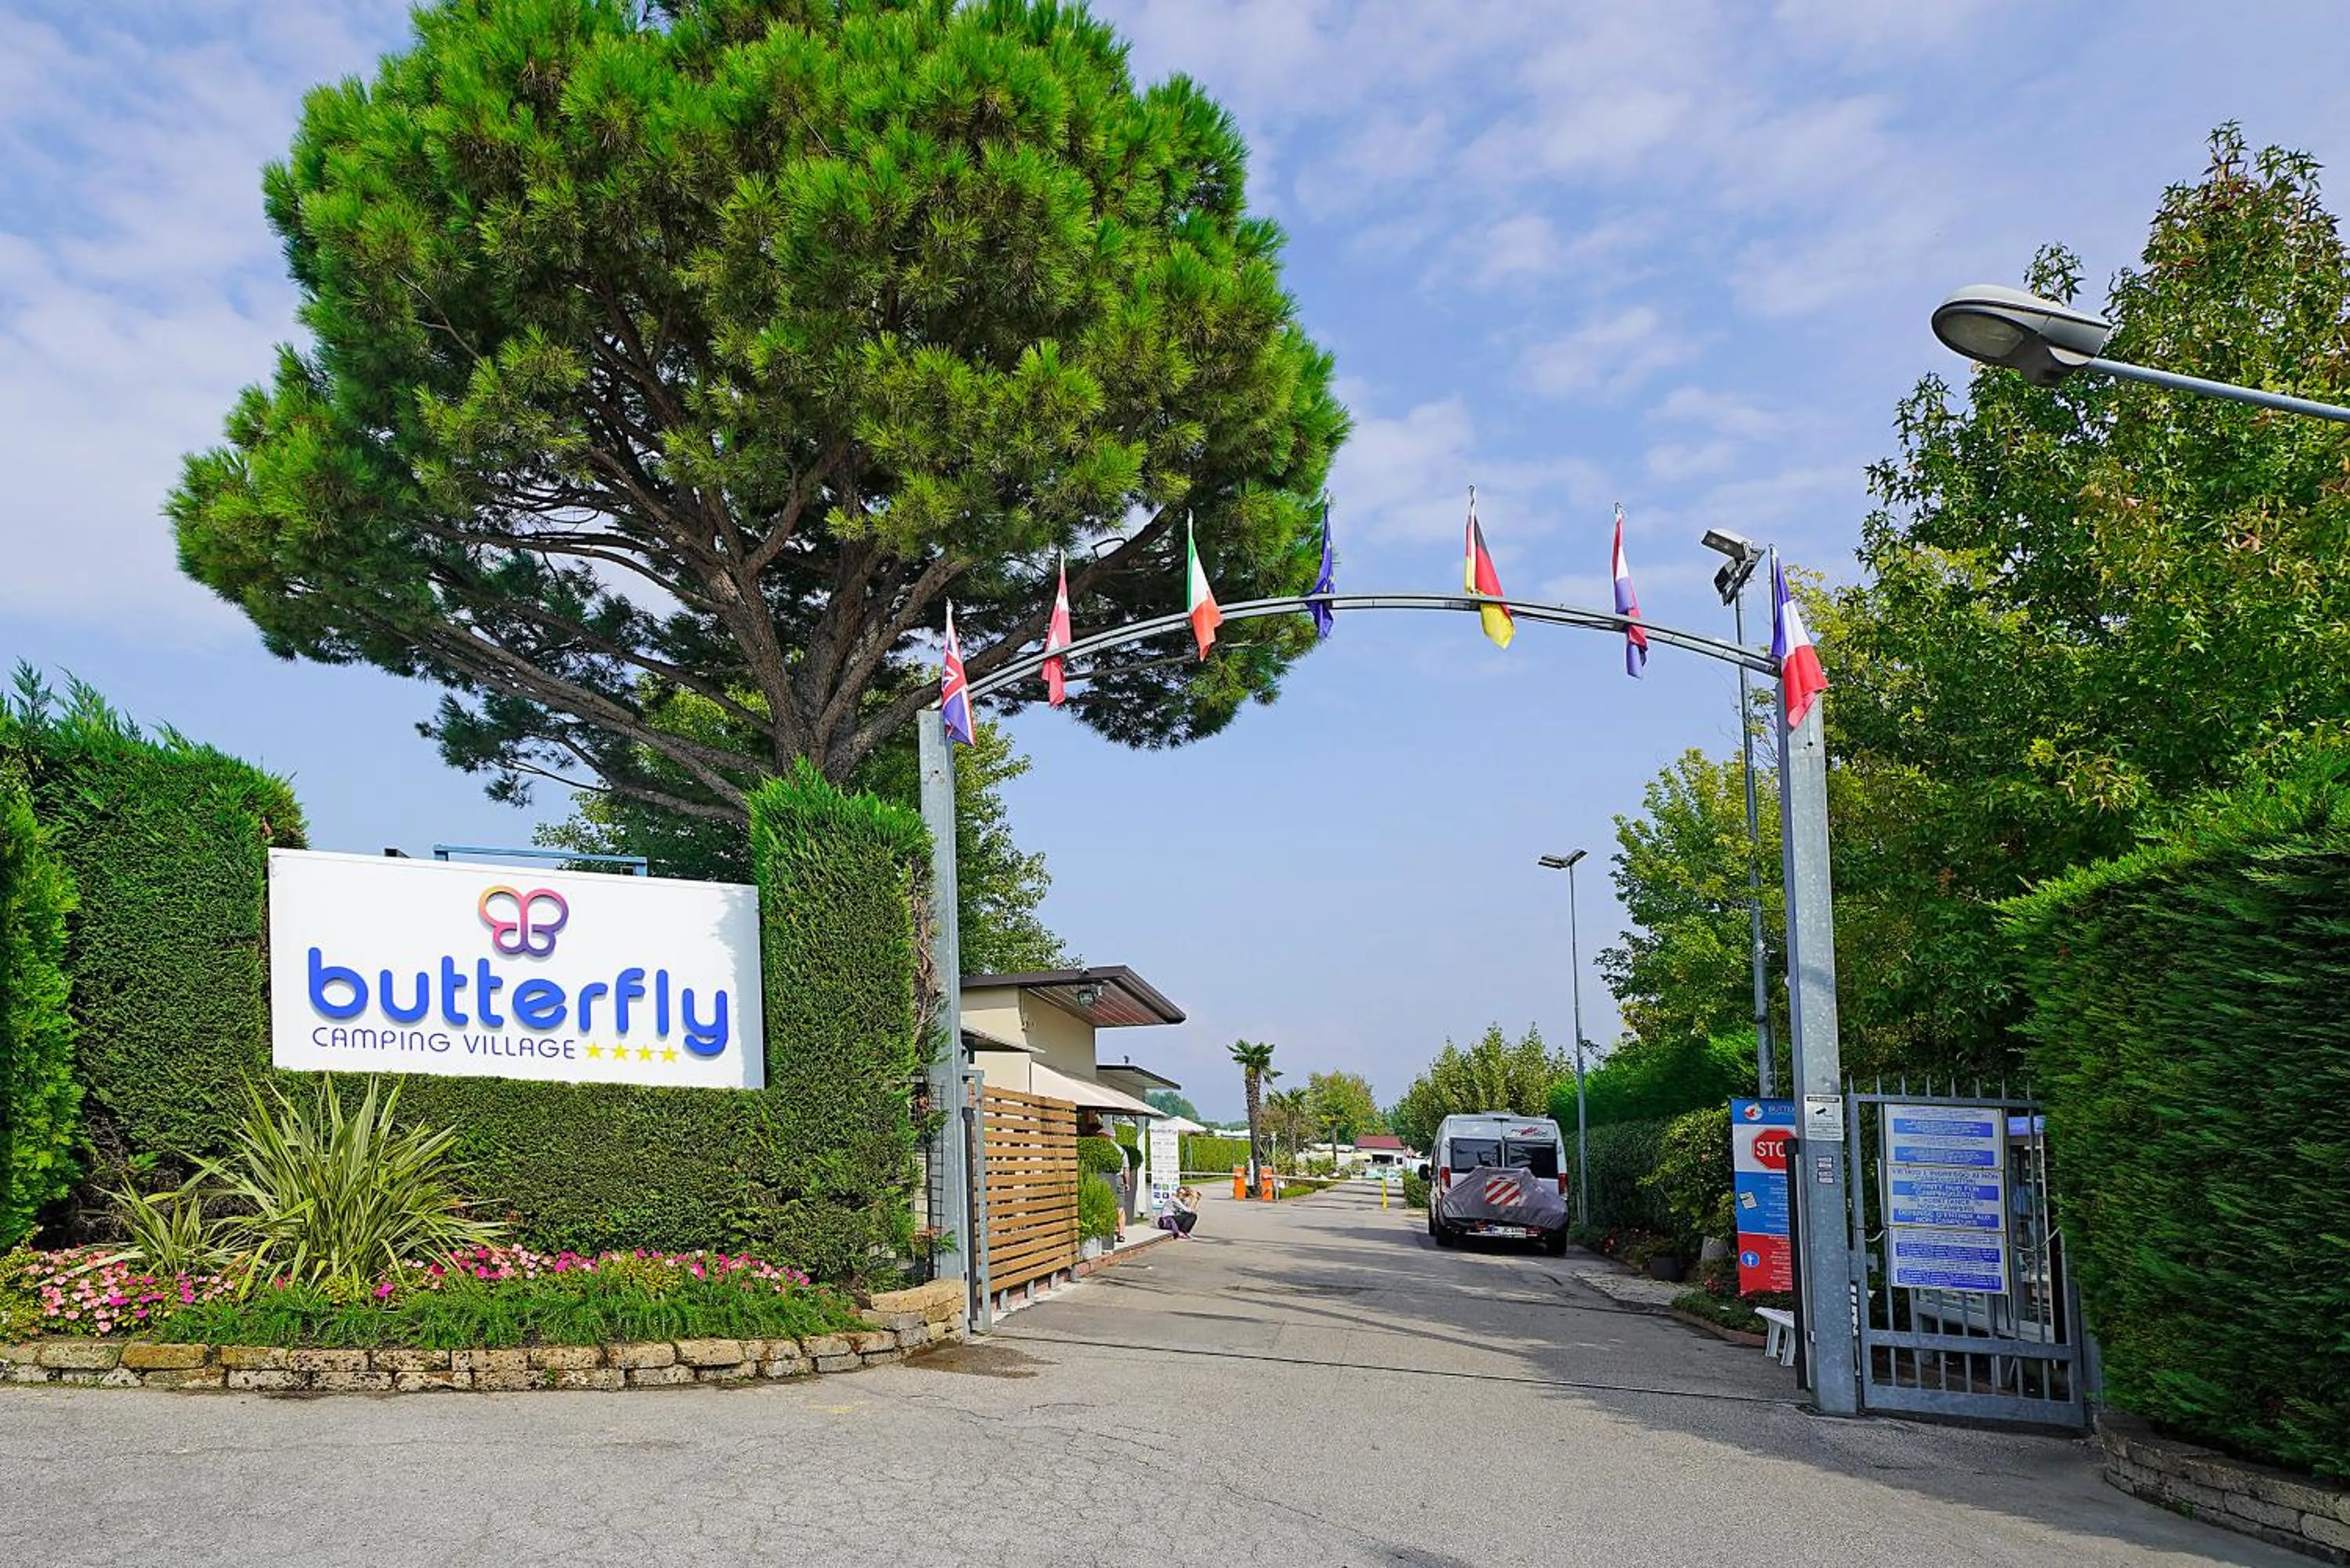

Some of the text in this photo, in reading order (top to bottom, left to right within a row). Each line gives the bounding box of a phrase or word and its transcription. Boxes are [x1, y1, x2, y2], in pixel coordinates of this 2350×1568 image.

[308, 947, 728, 1056] butterfly
[313, 1027, 576, 1060] CAMPING VILLAGE
[1756, 1141, 1786, 1157] STO
